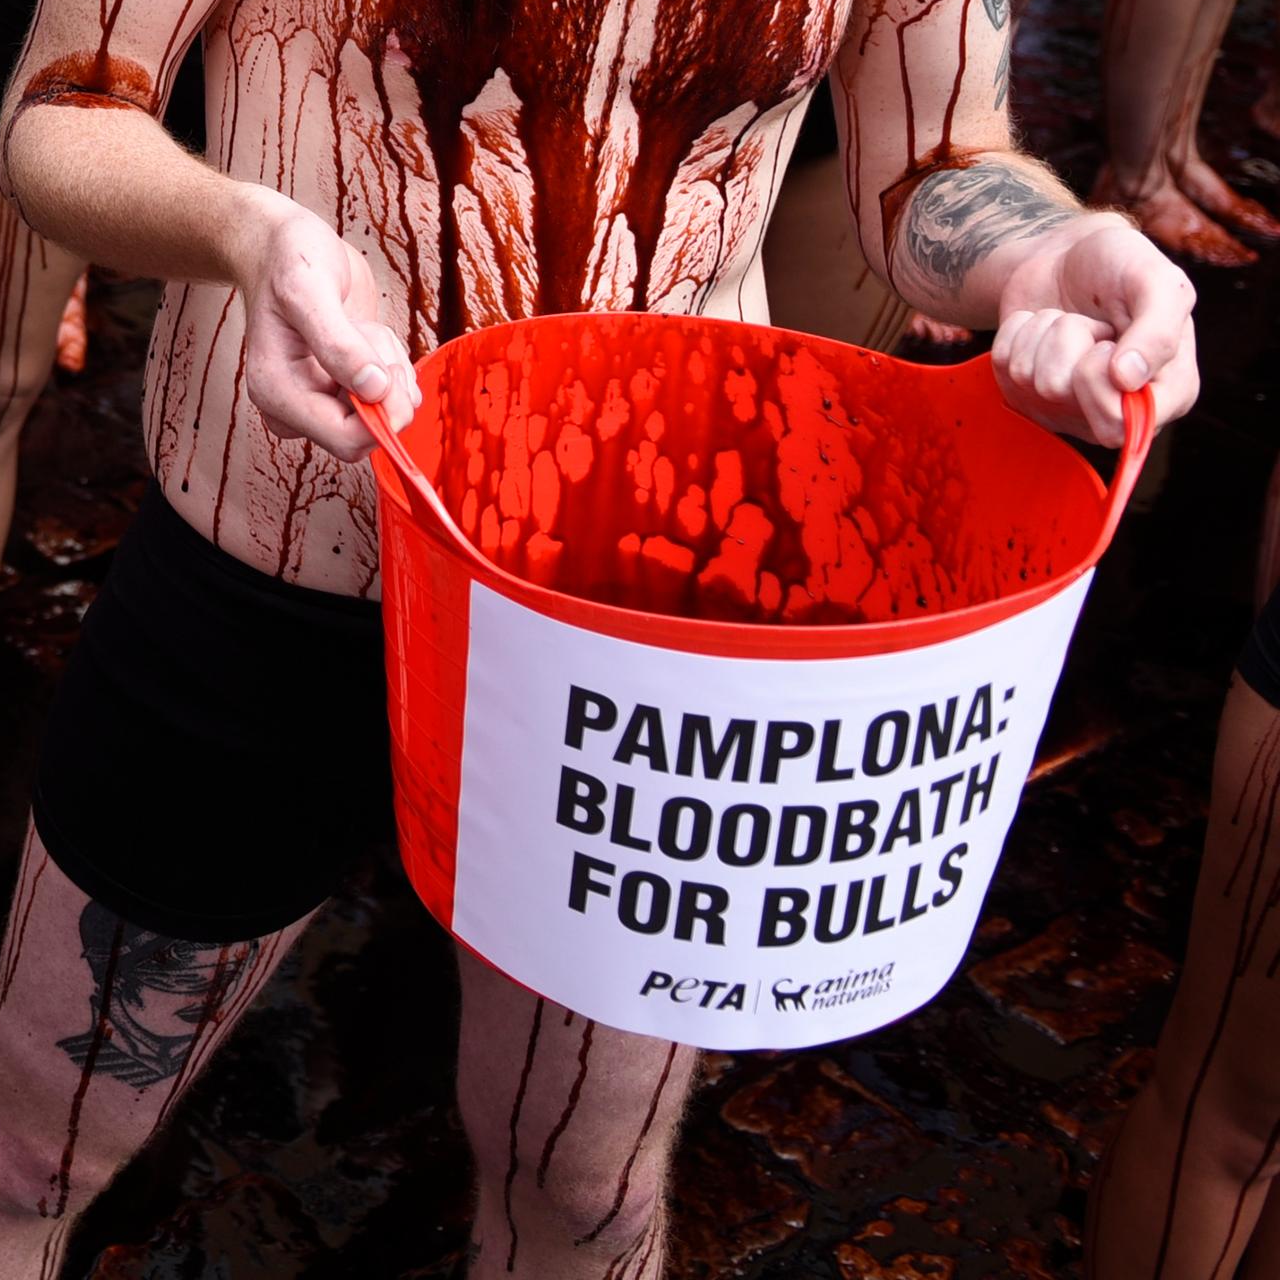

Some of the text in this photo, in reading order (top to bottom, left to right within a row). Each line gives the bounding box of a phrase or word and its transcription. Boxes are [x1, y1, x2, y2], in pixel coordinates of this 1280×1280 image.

[563, 682, 1017, 786] PAMPLONA:
[554, 752, 1002, 868] BLOODBATH
[565, 840, 969, 949] FOR BULLS
[810, 981, 895, 1012] naturalis
[813, 960, 897, 996] anima
